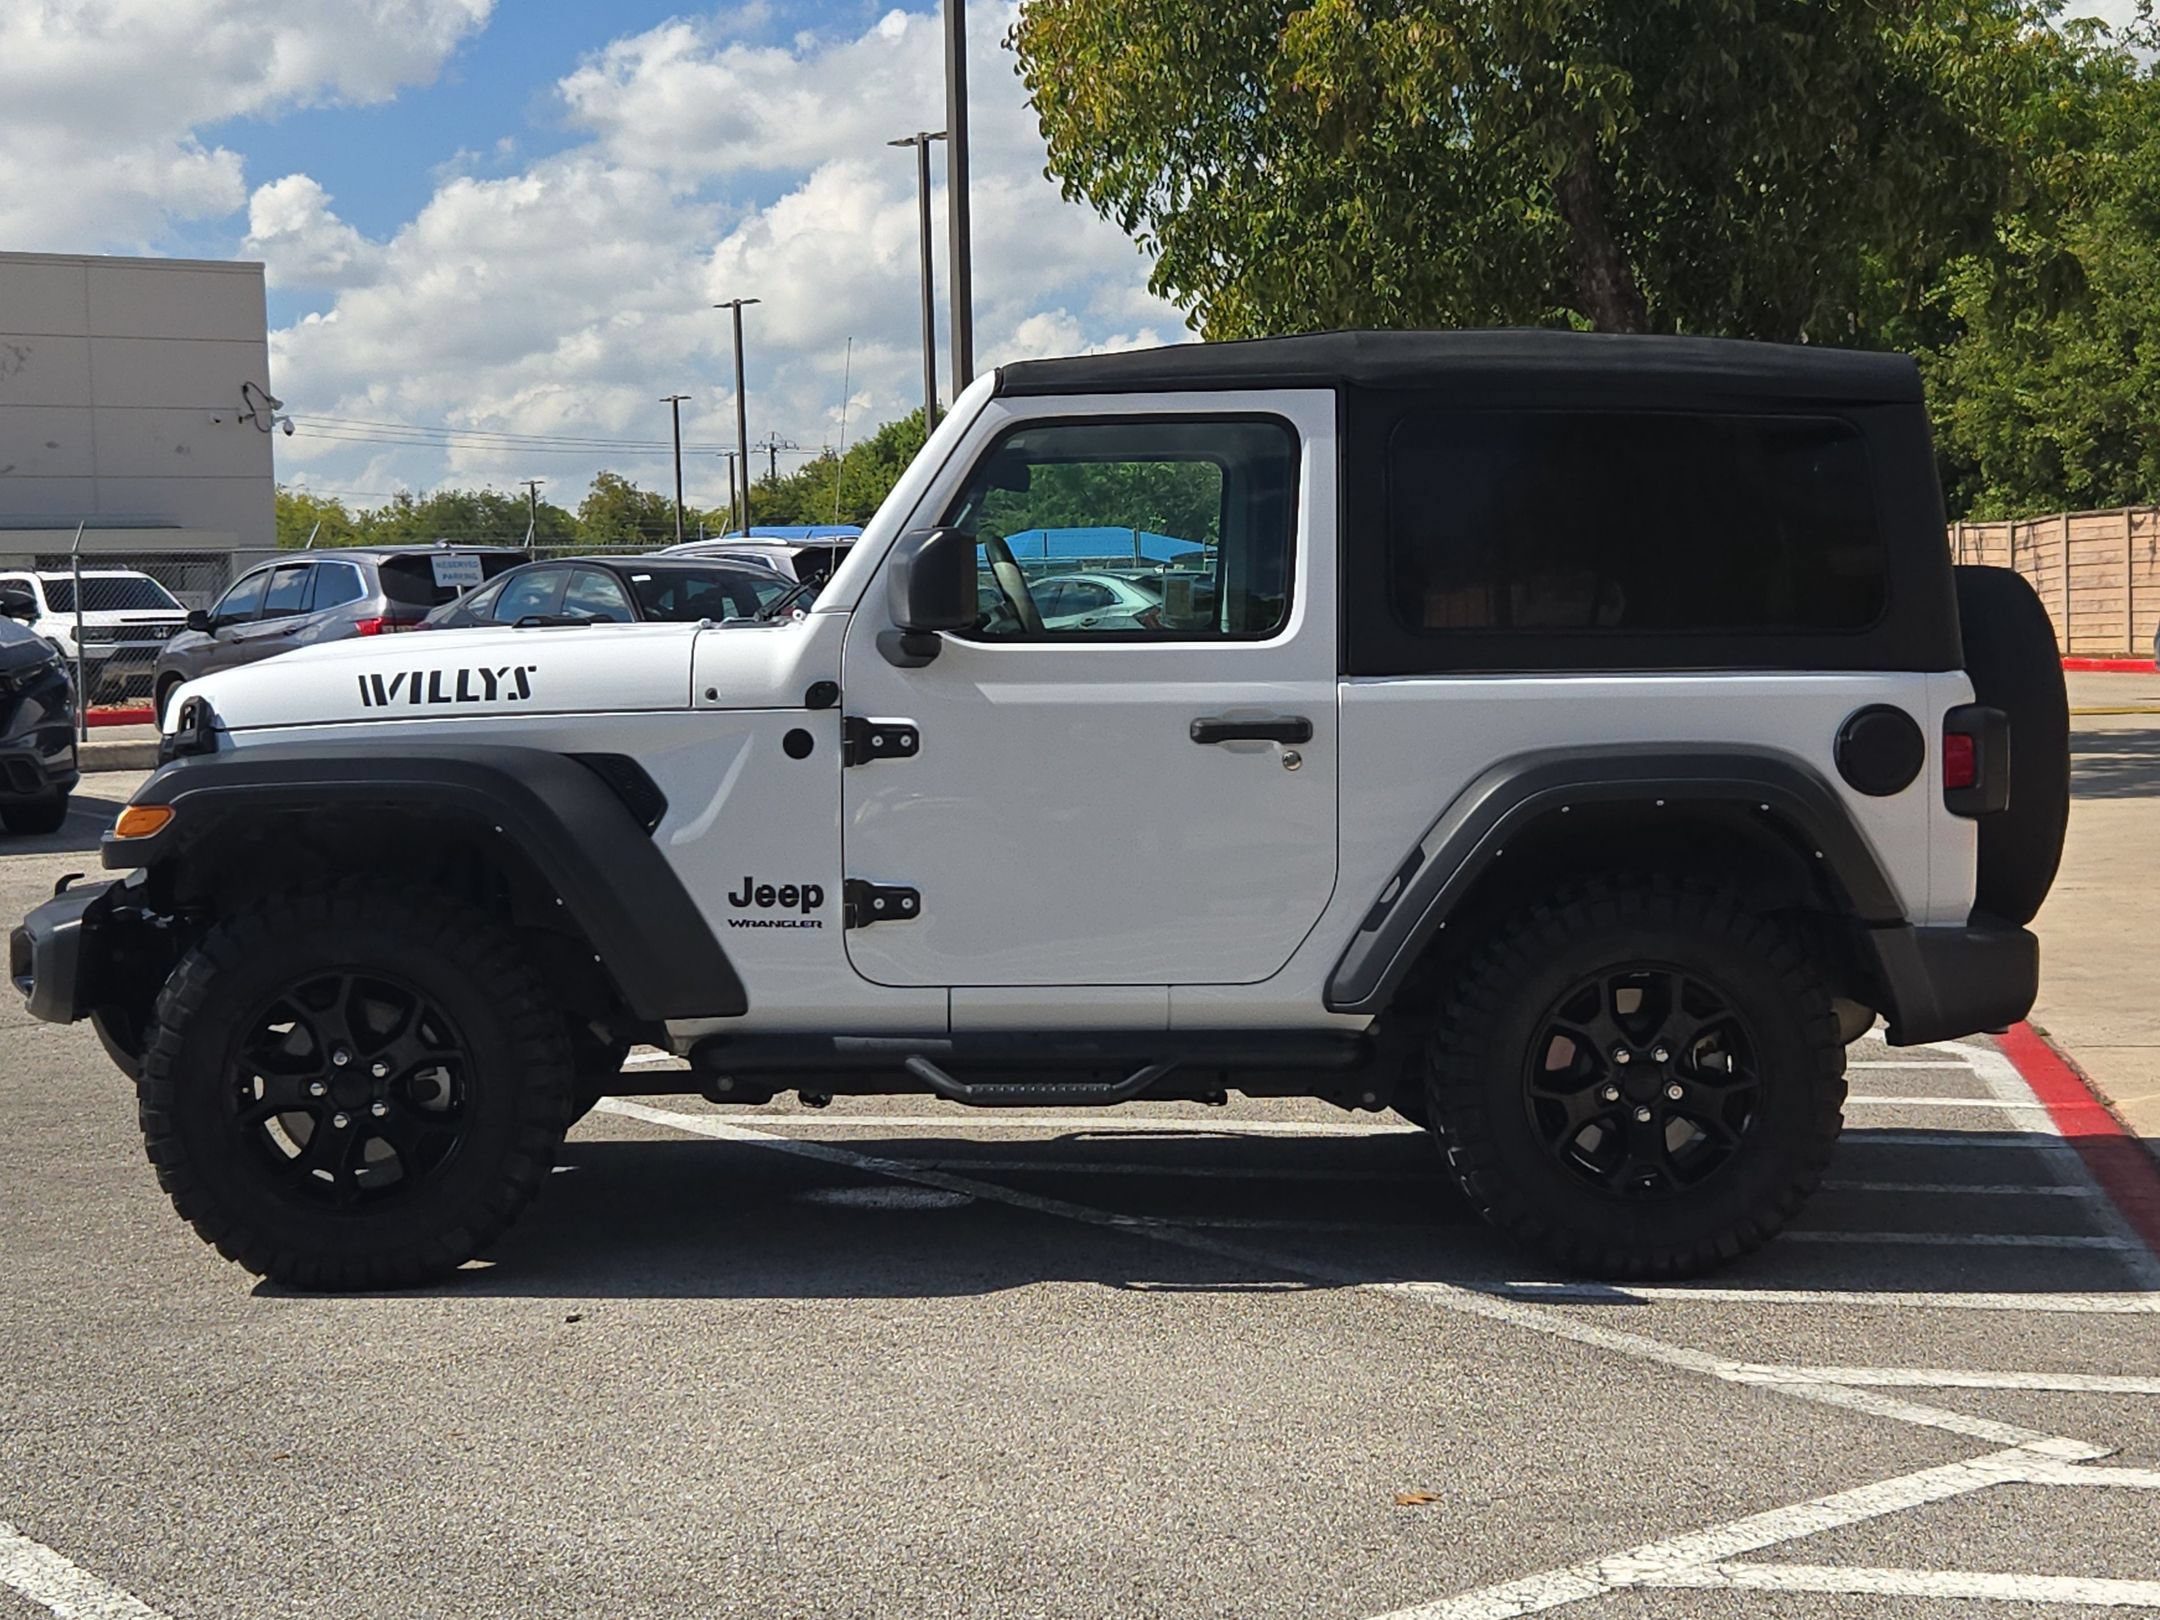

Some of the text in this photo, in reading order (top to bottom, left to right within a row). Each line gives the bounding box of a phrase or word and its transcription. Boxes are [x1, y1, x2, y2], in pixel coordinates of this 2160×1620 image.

[442, 572, 479, 580] PARKING
[358, 665, 537, 707] WILLYS
[728, 876, 825, 914] Jeep
[727, 918, 823, 929] WRANGLER
